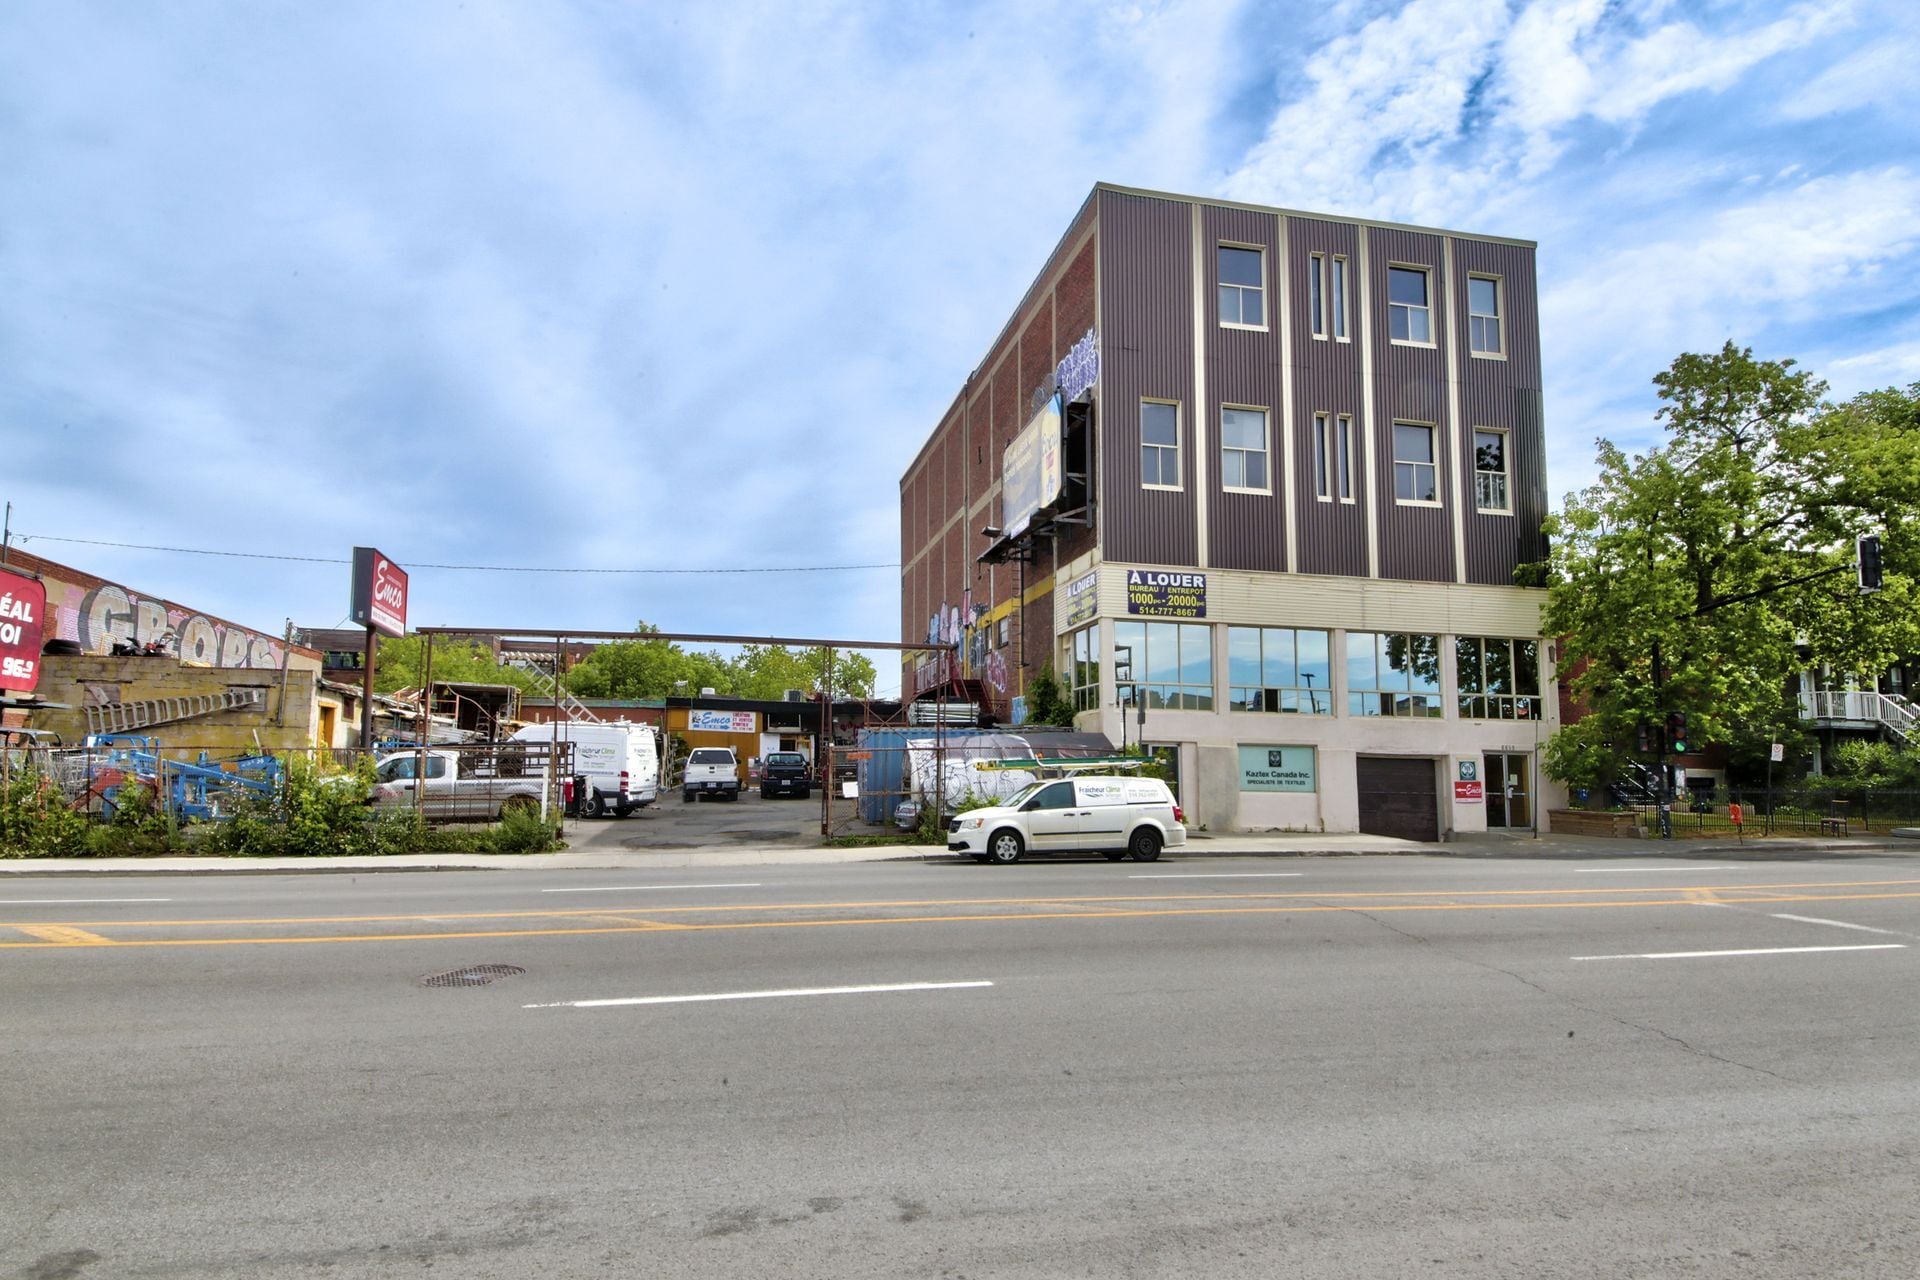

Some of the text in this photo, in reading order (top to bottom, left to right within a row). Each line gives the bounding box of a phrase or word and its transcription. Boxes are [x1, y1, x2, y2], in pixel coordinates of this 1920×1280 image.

[1130, 569, 1204, 588] À LOUER
[1129, 585, 1159, 593] BUREAU
[1167, 587, 1204, 595] ENTREPOT
[1139, 607, 1197, 616] 514-777-8667
[702, 712, 731, 724] Emco
